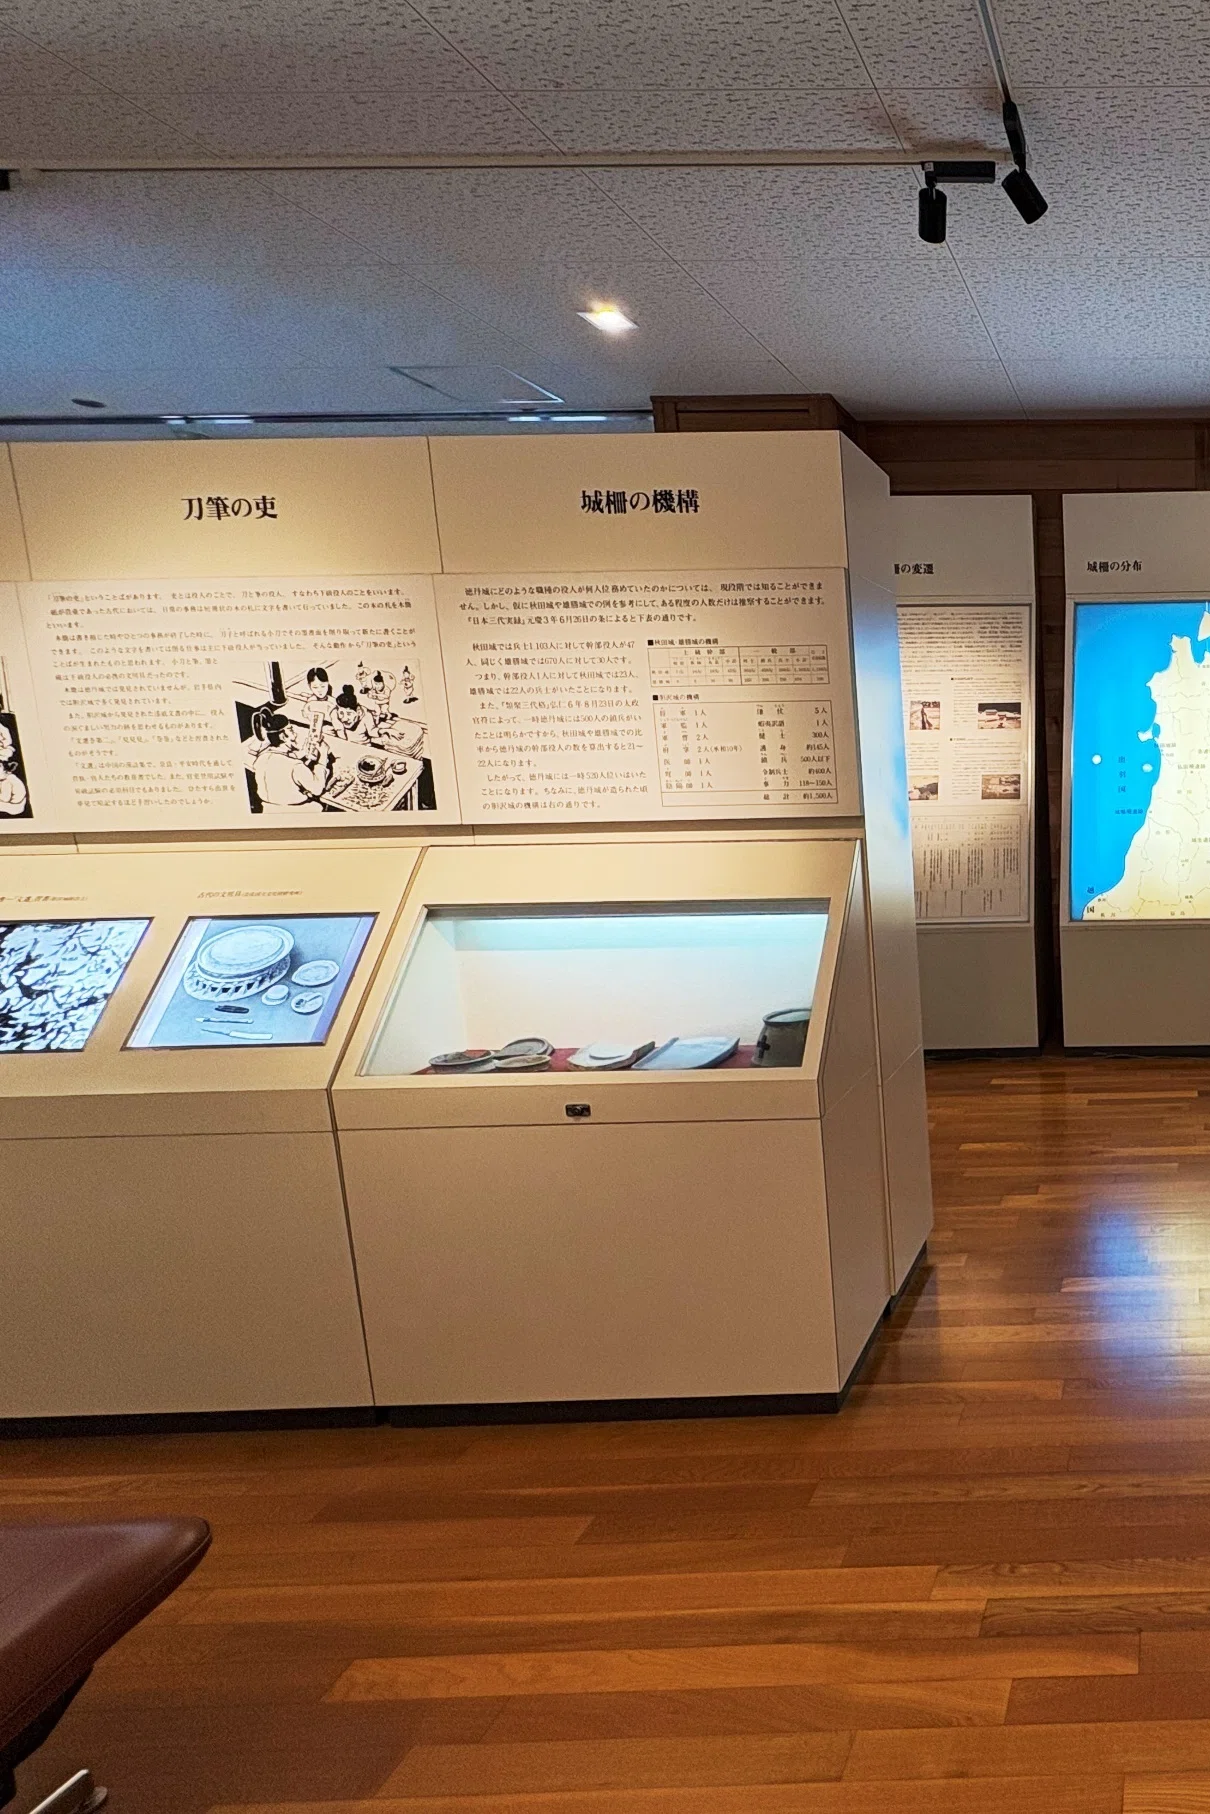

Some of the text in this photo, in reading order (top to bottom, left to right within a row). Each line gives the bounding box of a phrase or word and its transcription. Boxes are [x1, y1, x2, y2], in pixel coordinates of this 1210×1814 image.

[181, 494, 279, 521] 刀筆の吏
[580, 489, 701, 514] 城柵の機構
[1087, 560, 1143, 572] 城柵の分布
